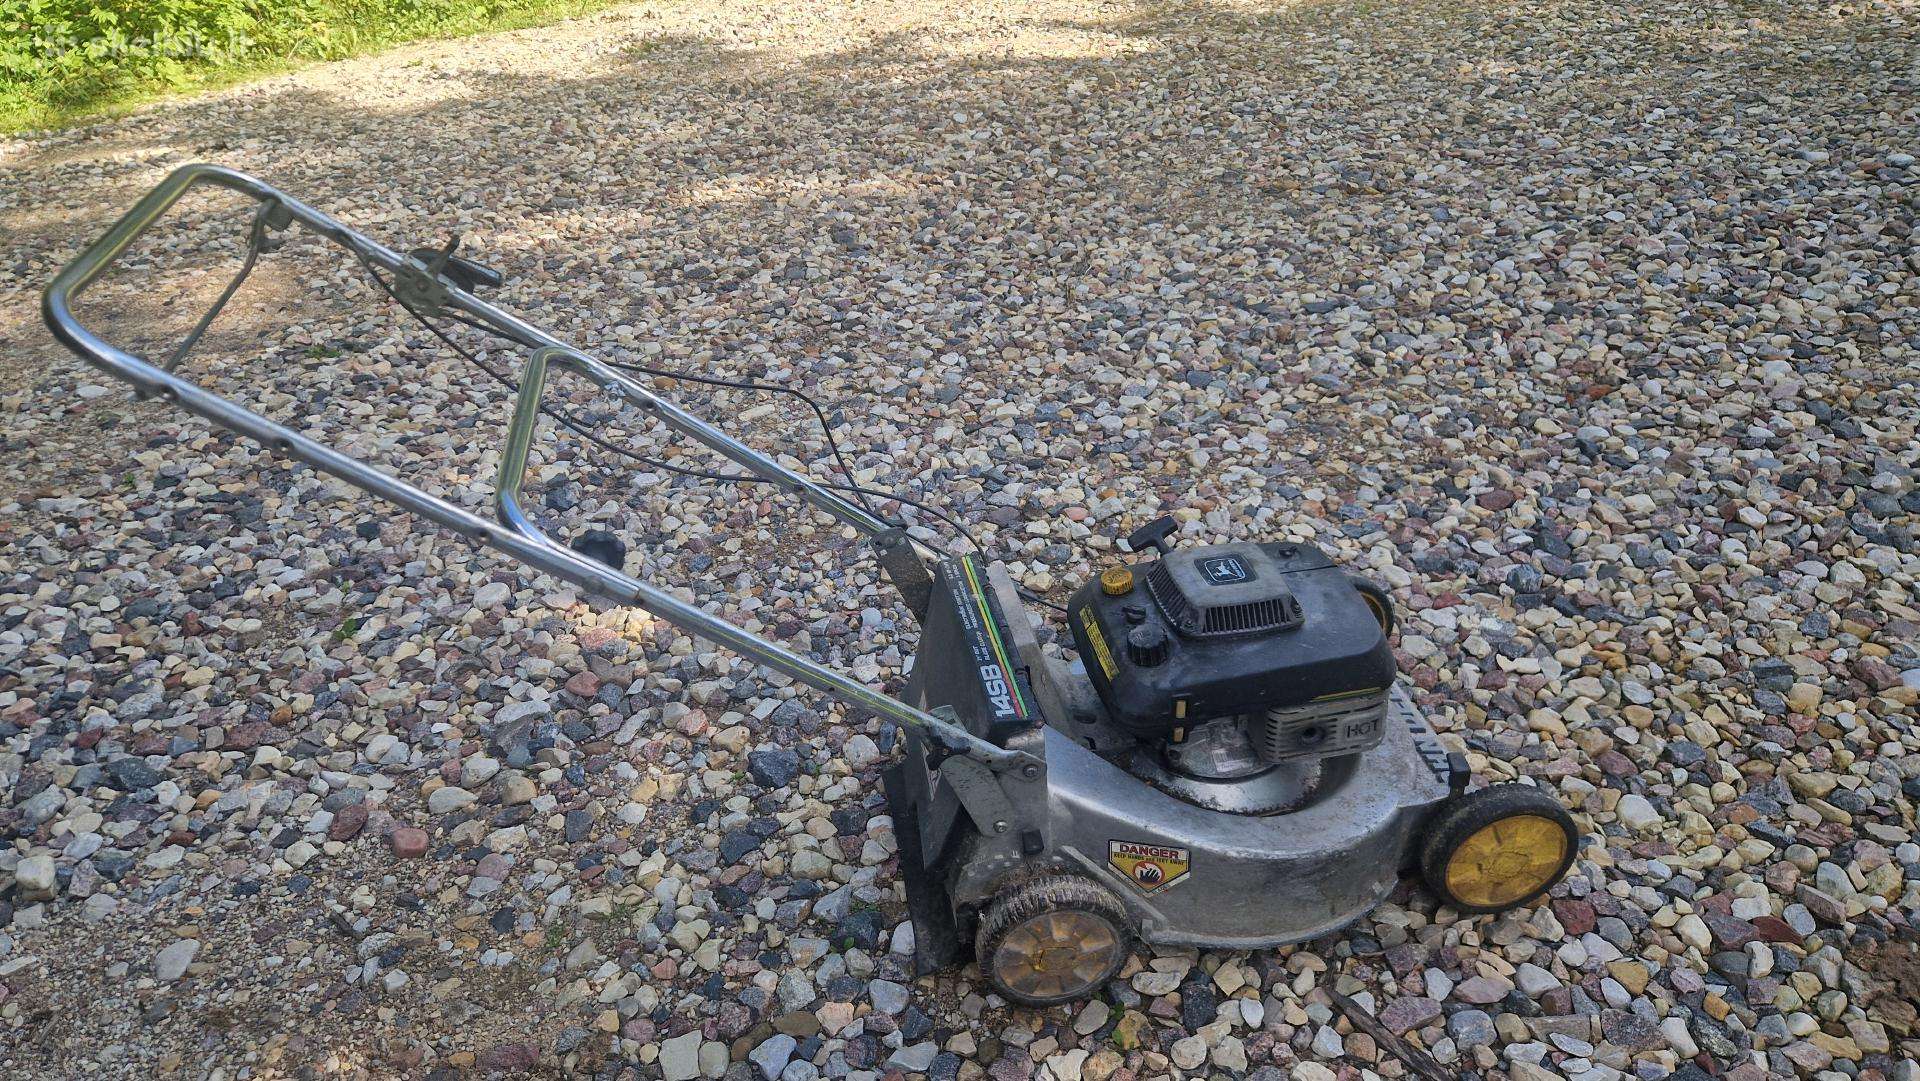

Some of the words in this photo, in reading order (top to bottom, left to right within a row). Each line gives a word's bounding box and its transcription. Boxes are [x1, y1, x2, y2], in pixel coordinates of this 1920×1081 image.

[980, 664, 1015, 717] 14SB
[1346, 718, 1379, 738] HOT
[1120, 844, 1179, 859] DANGER
[1127, 853, 1145, 861] HANDS
